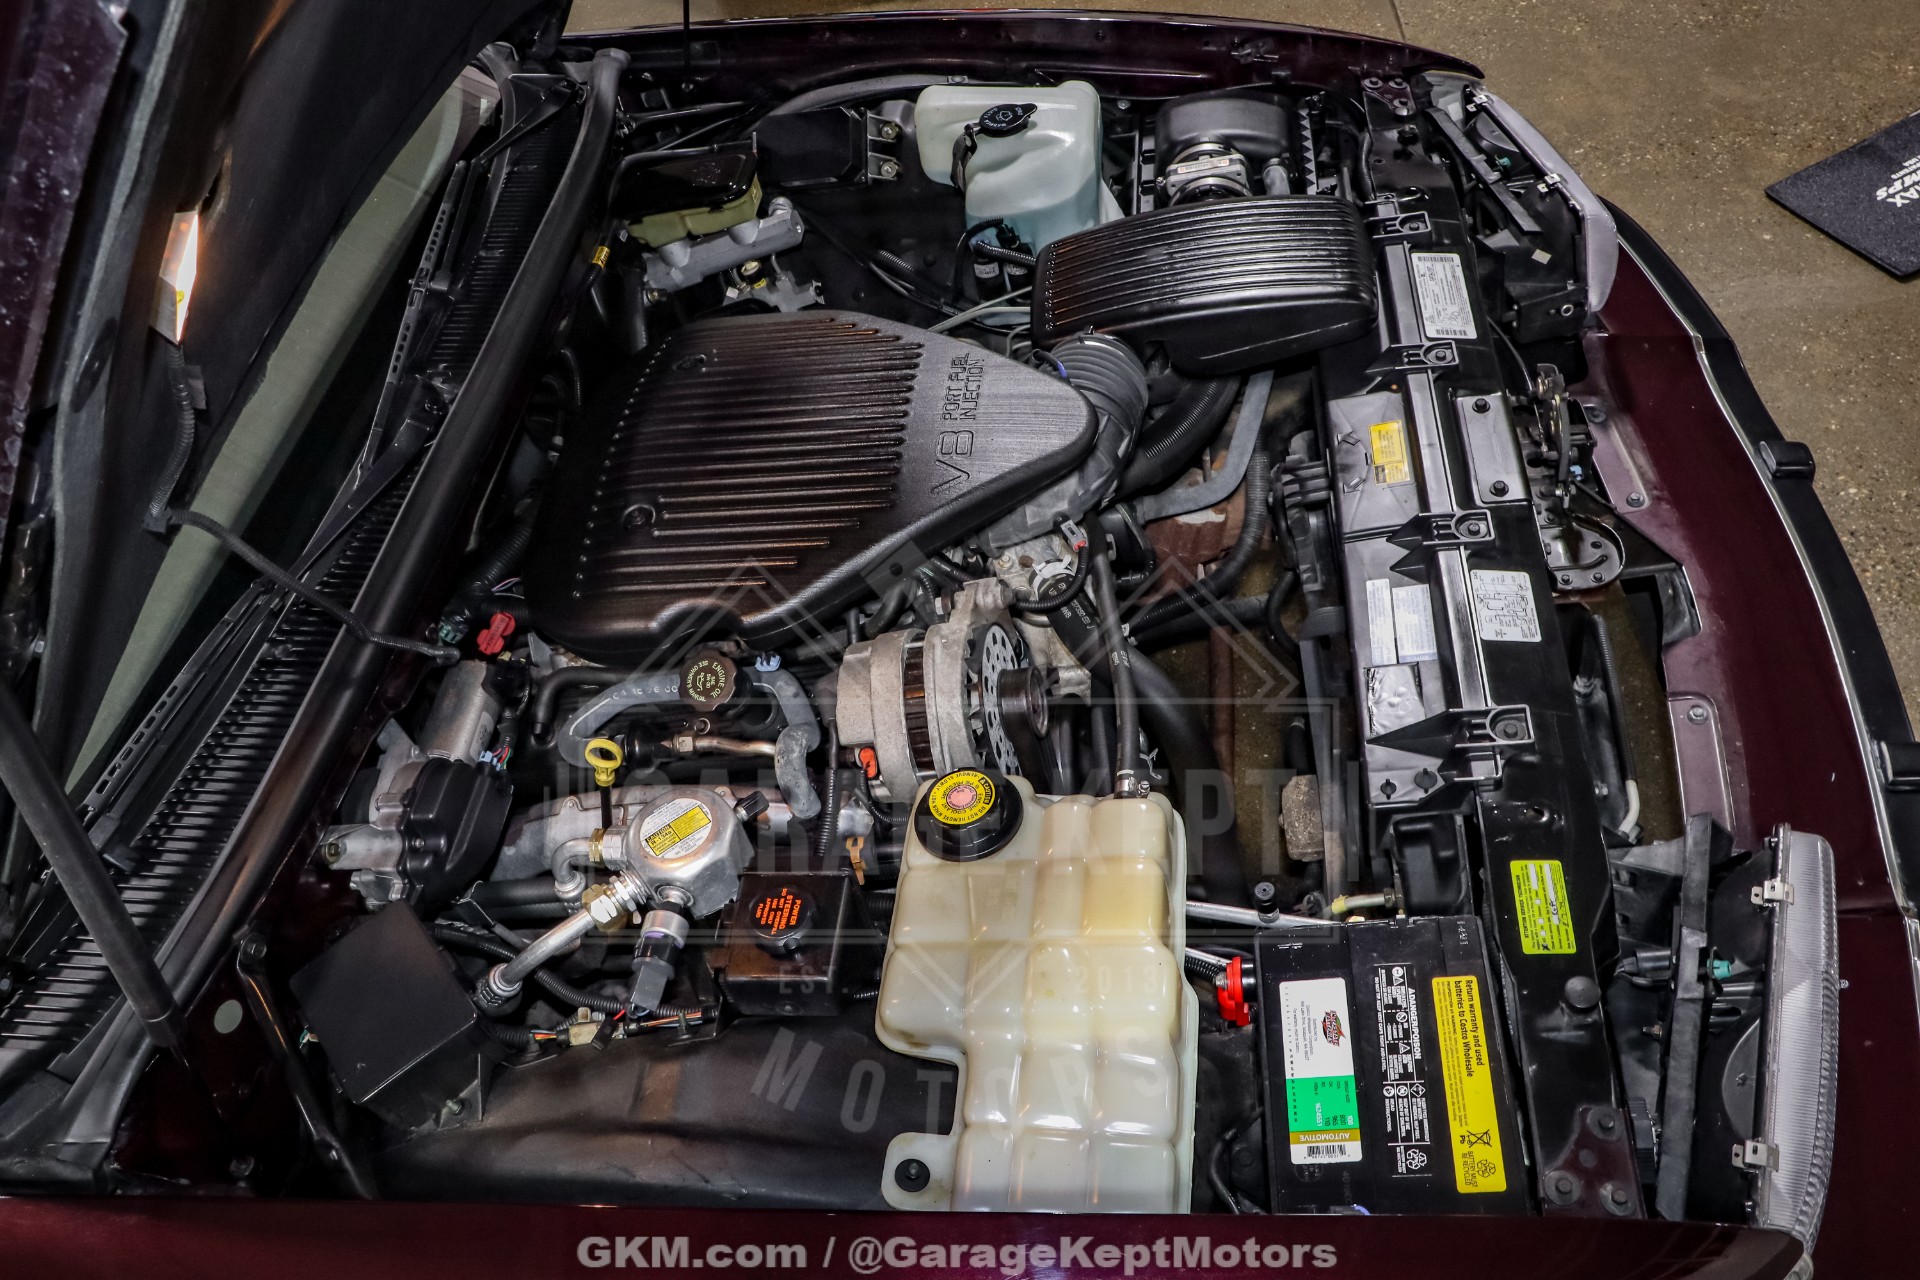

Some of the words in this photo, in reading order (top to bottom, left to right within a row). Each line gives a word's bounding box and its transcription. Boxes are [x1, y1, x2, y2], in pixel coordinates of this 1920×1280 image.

[947, 352, 969, 381] FUEL
[959, 358, 984, 421] INJECTION
[941, 386, 962, 420] PORT
[929, 429, 973, 495] V8
[712, 662, 725, 687] ENGINE
[710, 688, 721, 698] OIL
[941, 803, 967, 814] COOLANT
[968, 793, 984, 812] ENGINE
[943, 814, 966, 822] REMOVE
[646, 824, 671, 842] CAUTION
[650, 830, 672, 845] R-134a
[781, 888, 787, 896] DO
[755, 903, 763, 918] FLUID
[760, 897, 771, 924] APPROVED
[778, 894, 793, 929] STEERING
[789, 898, 801, 925] POWER
[770, 910, 781, 935] OVERFILL
[1454, 980, 1465, 1009] batteries
[1464, 979, 1475, 1001] Return
[1324, 1010, 1333, 1044] BATTERIES
[1330, 1010, 1339, 1047] INTERSTATE
[1408, 993, 1421, 1059] DANGER/POISON
[1459, 1018, 1469, 1040] Costco
[1466, 1003, 1479, 1034] warranty
[1472, 1034, 1481, 1047] and
[1462, 1041, 1475, 1077] Wholesale
[1474, 1048, 1484, 1066] used
[1314, 1102, 1322, 1126] 1624551
[1298, 1132, 1350, 1141] AUTOMOTIVE
[1459, 1134, 1465, 1144] Pb
[1461, 1152, 1468, 1160] BE
[1466, 1150, 1475, 1172] BATTERY
[1461, 1160, 1471, 1185] RECYCLED
[1468, 1173, 1477, 1187] MUST
